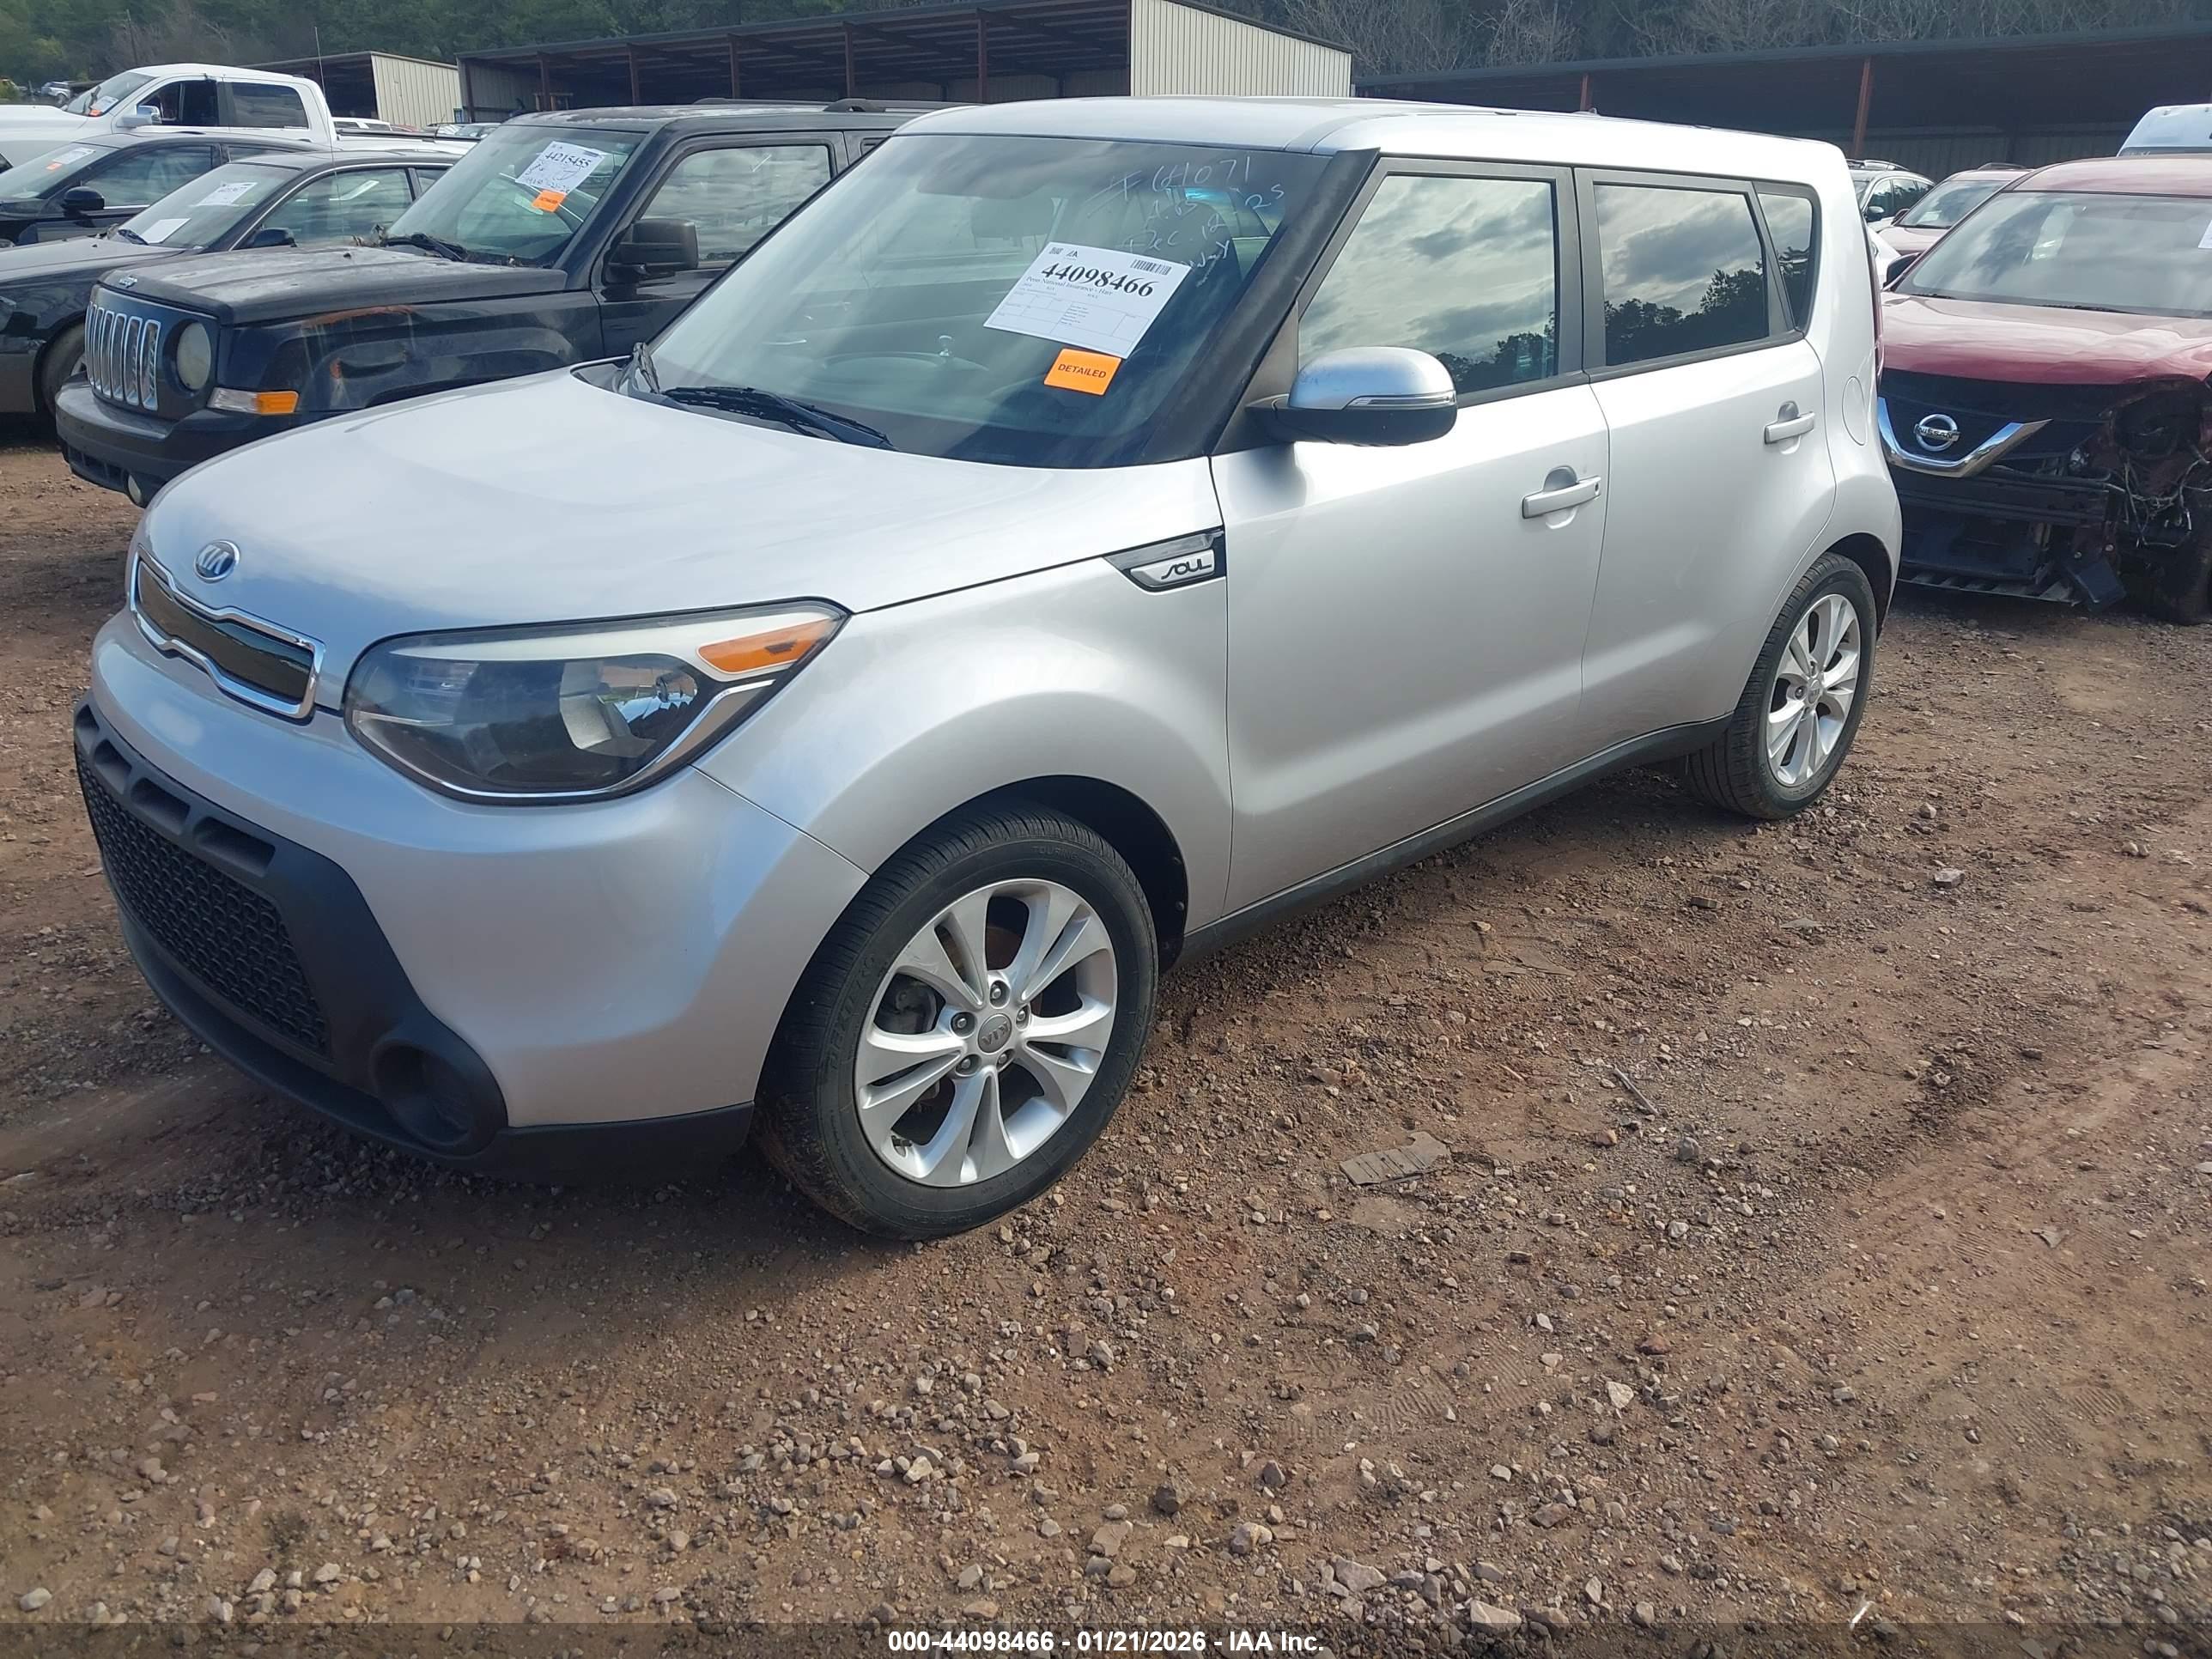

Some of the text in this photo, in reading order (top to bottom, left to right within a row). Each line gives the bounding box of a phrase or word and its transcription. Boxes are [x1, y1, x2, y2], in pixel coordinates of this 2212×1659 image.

[1041, 262, 1160, 297] 44098466
[1042, 277, 1066, 287] National
[1066, 281, 1094, 292] Insurance
[1057, 362, 1108, 380] DETAILED
[1918, 426, 1953, 440] NISSAN
[1161, 558, 1212, 580] SOUL
[981, 1019, 1011, 1046] KIA
